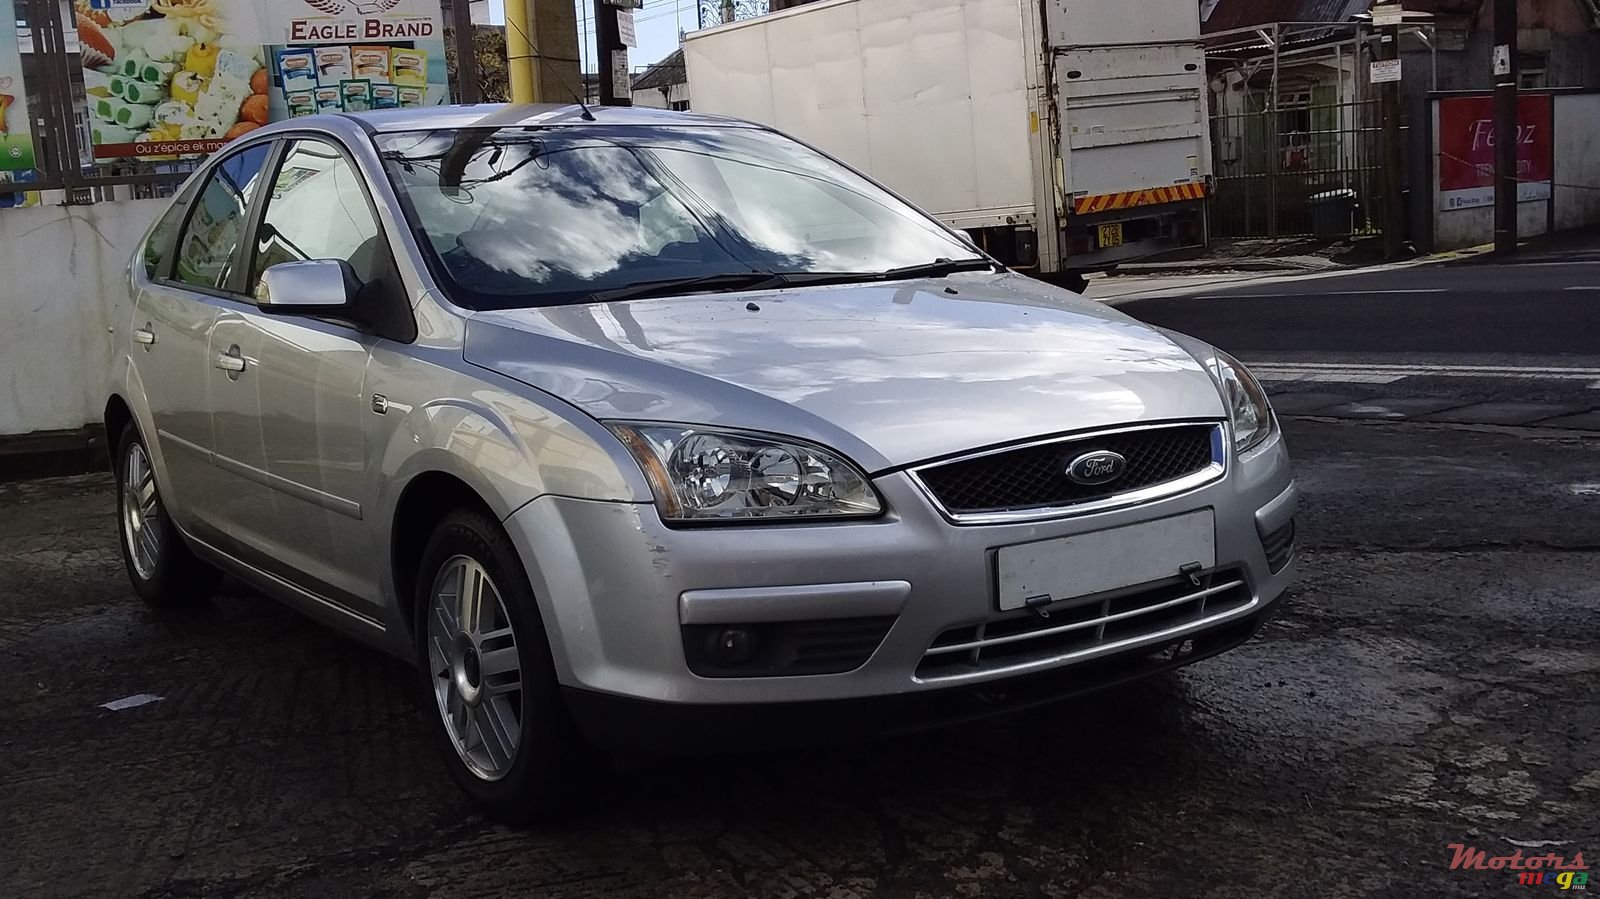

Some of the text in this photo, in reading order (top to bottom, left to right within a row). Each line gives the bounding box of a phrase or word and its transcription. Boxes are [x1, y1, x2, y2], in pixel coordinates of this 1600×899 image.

[291, 18, 433, 41] EAGLE BRAND
[1468, 119, 1536, 152] Fez
[135, 144, 152, 154] Ou
[192, 141, 205, 151] ek
[1084, 457, 1114, 477] Ford
